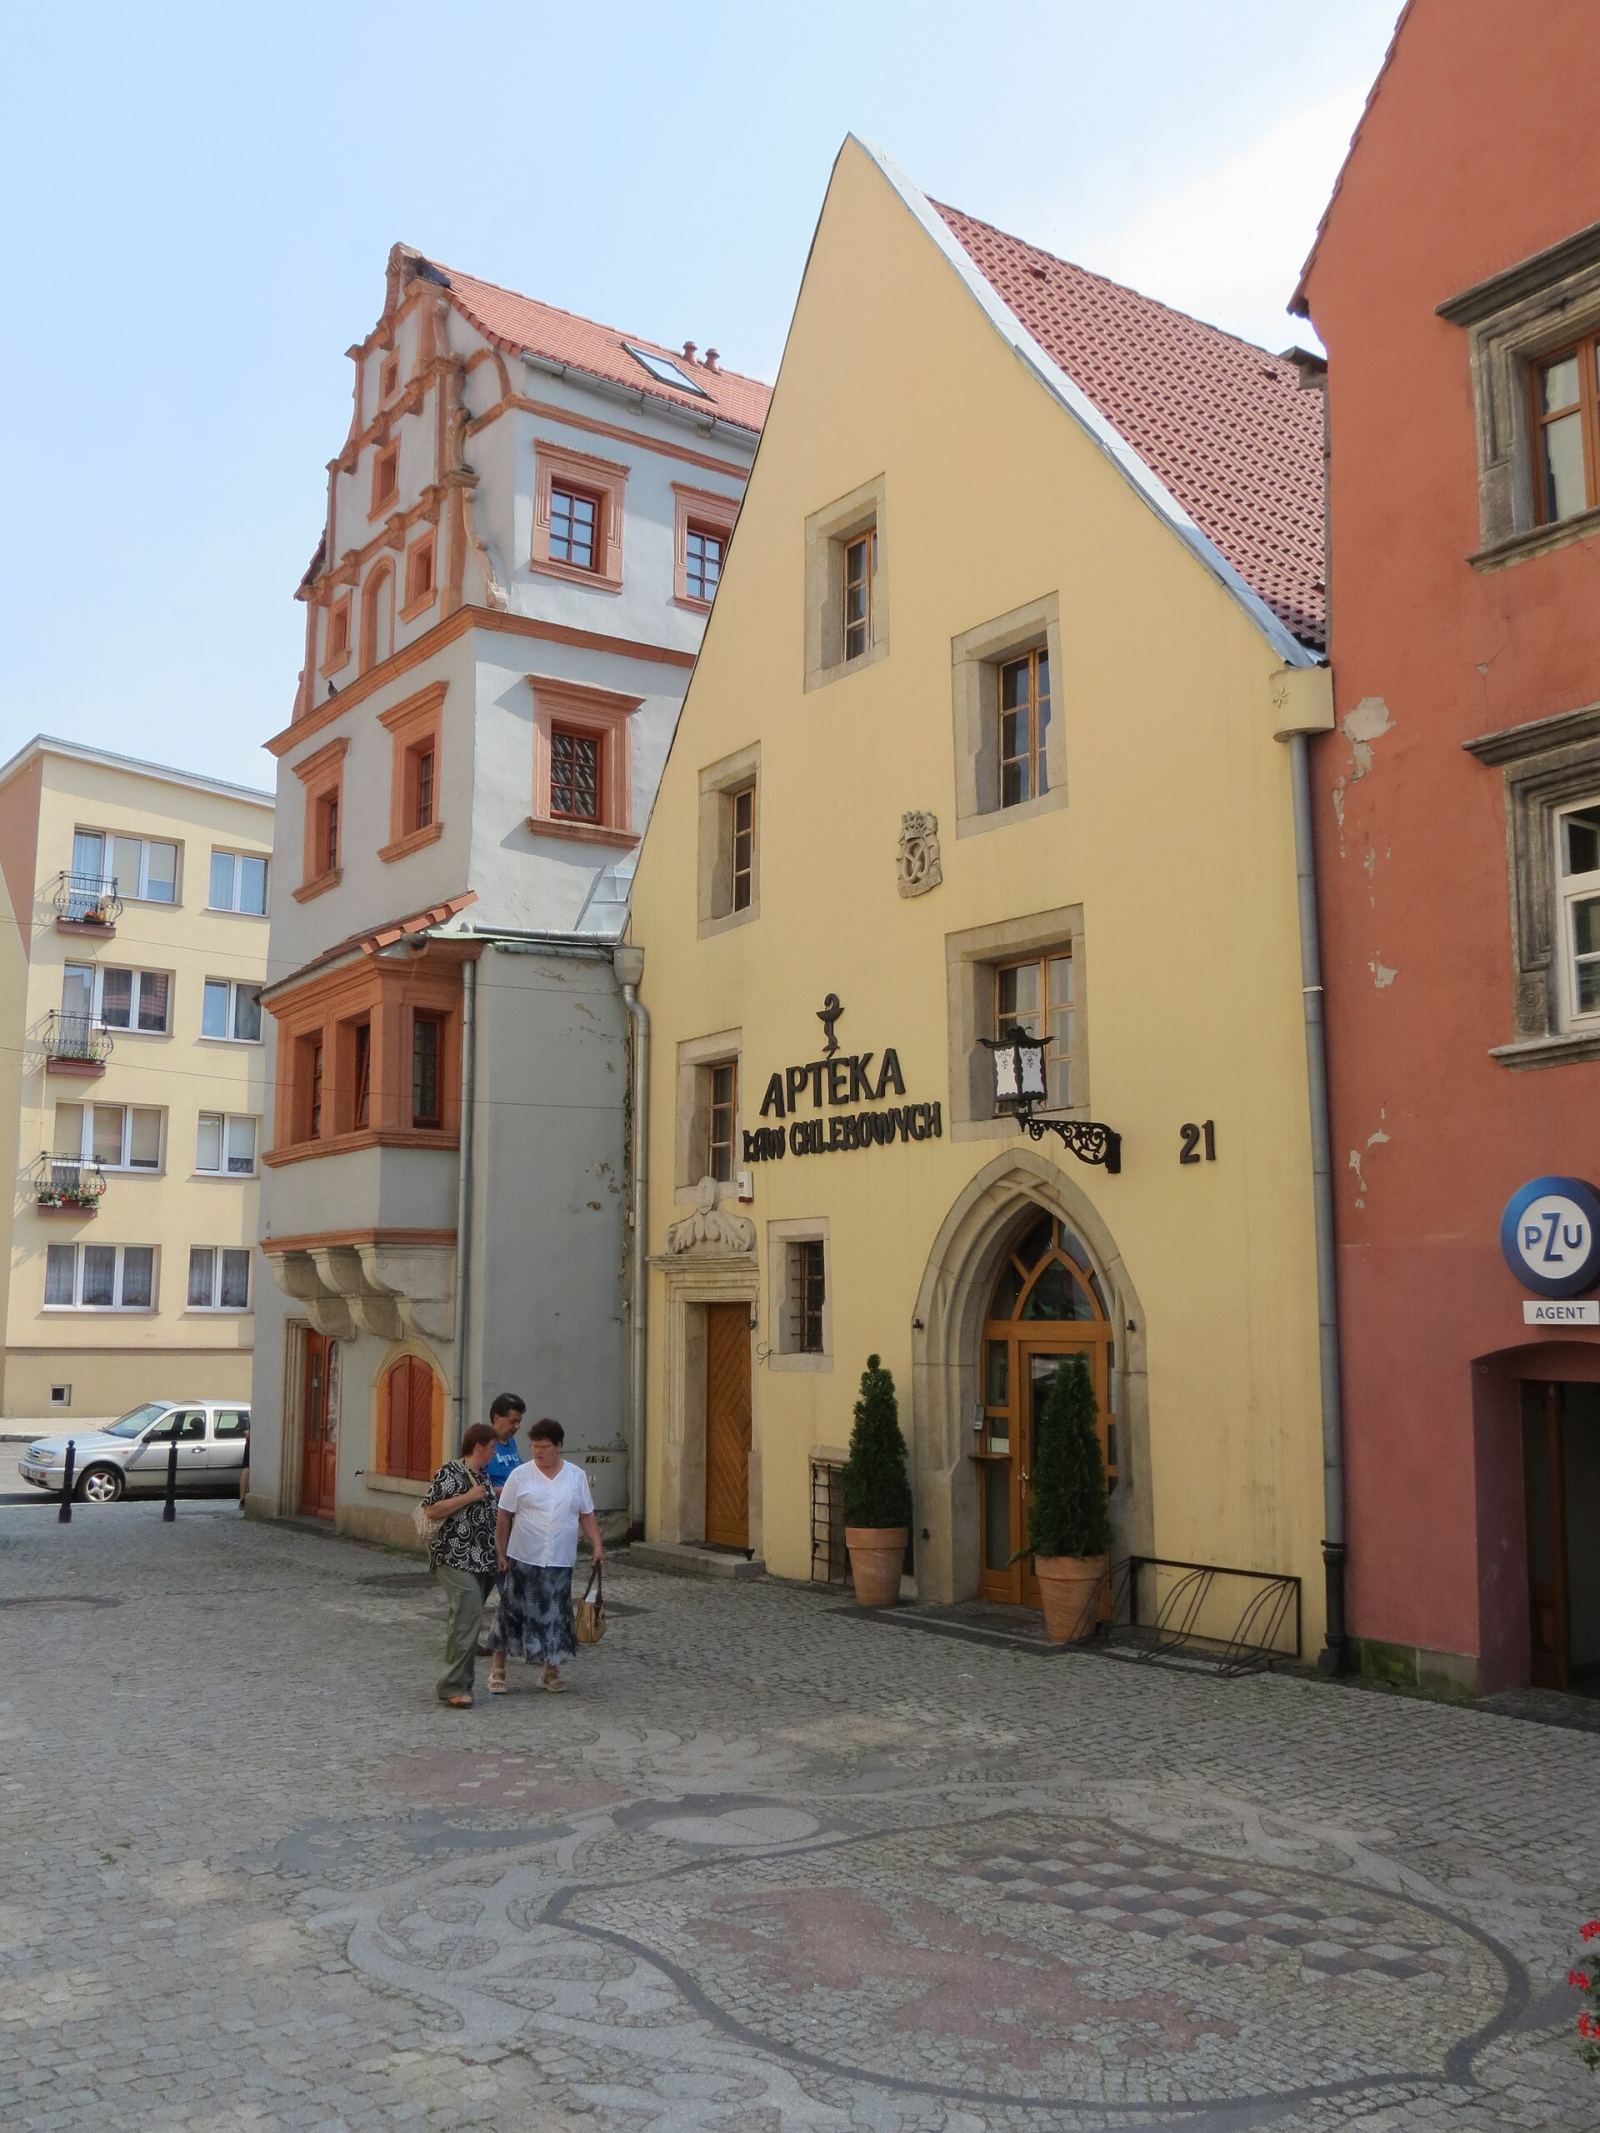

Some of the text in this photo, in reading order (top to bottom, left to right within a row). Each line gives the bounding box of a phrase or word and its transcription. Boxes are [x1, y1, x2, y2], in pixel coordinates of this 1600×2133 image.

[759, 1048, 906, 1118] APTEKA
[743, 1101, 942, 1163] ŁAW CHLEBOWYCH
[1180, 1119, 1216, 1164] 21
[1524, 1213, 1584, 1262] PZU
[1535, 1306, 1586, 1320] AGENT
